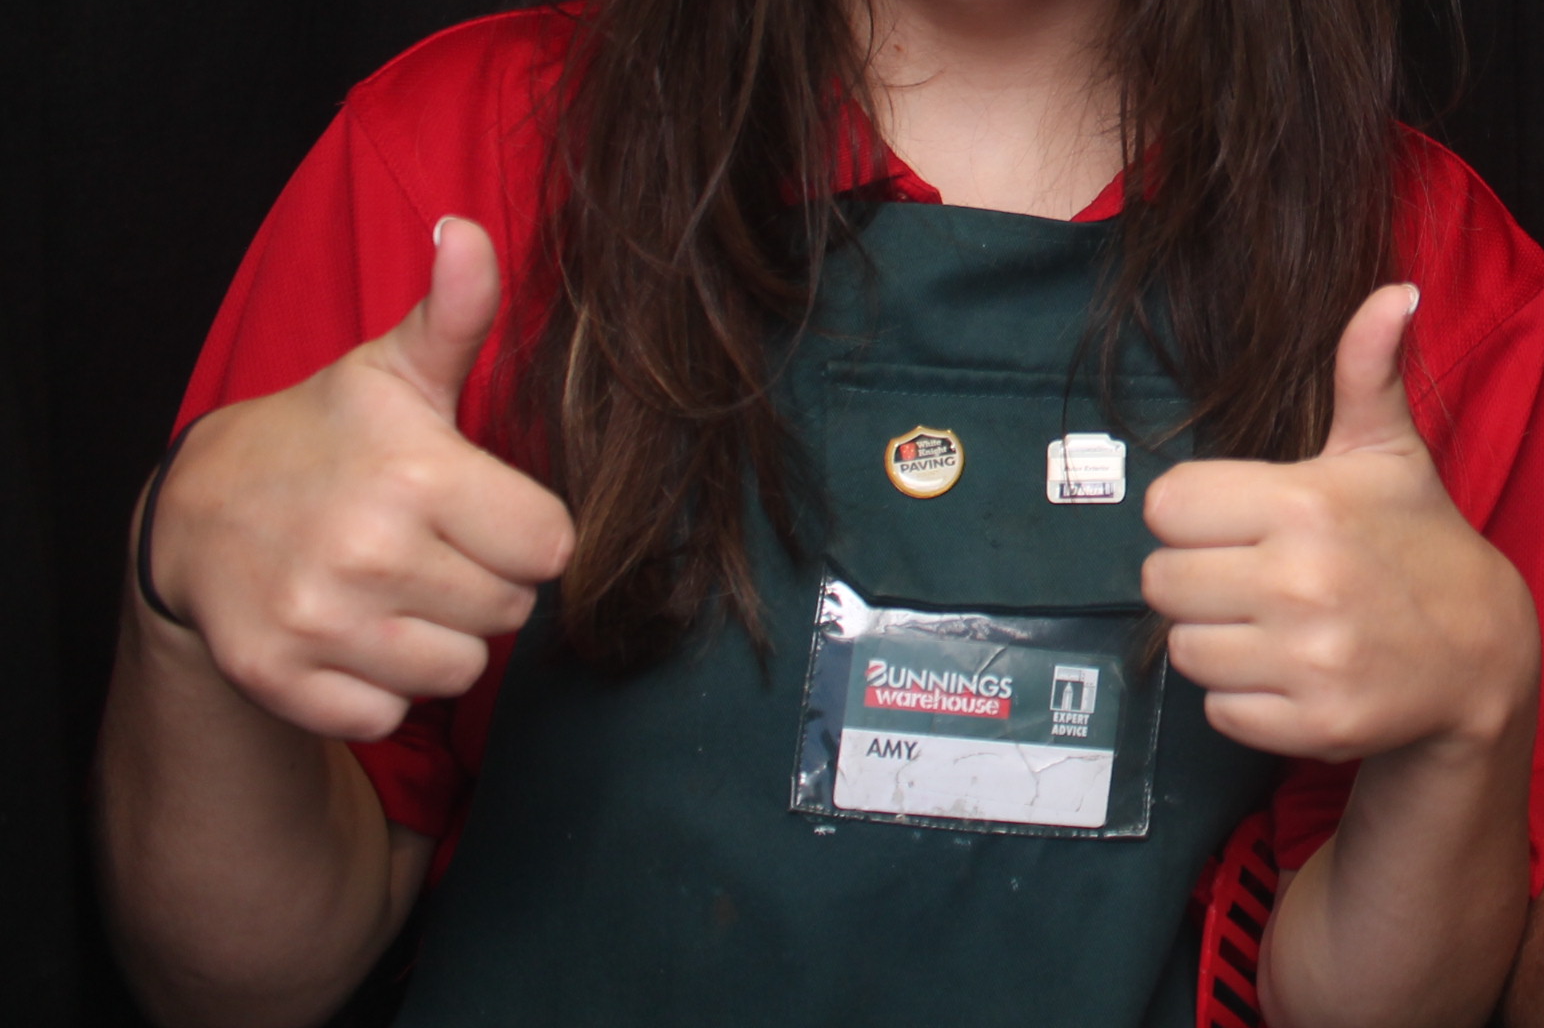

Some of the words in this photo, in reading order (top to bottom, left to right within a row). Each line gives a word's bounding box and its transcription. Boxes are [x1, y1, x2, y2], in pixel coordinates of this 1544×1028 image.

[900, 456, 956, 473] PAVING
[866, 660, 1013, 699] BUNNINGS
[876, 685, 1000, 716] warehouse
[1053, 712, 1090, 725] EXPERT
[1051, 724, 1088, 737] ADVICE
[866, 738, 918, 760] AMY
